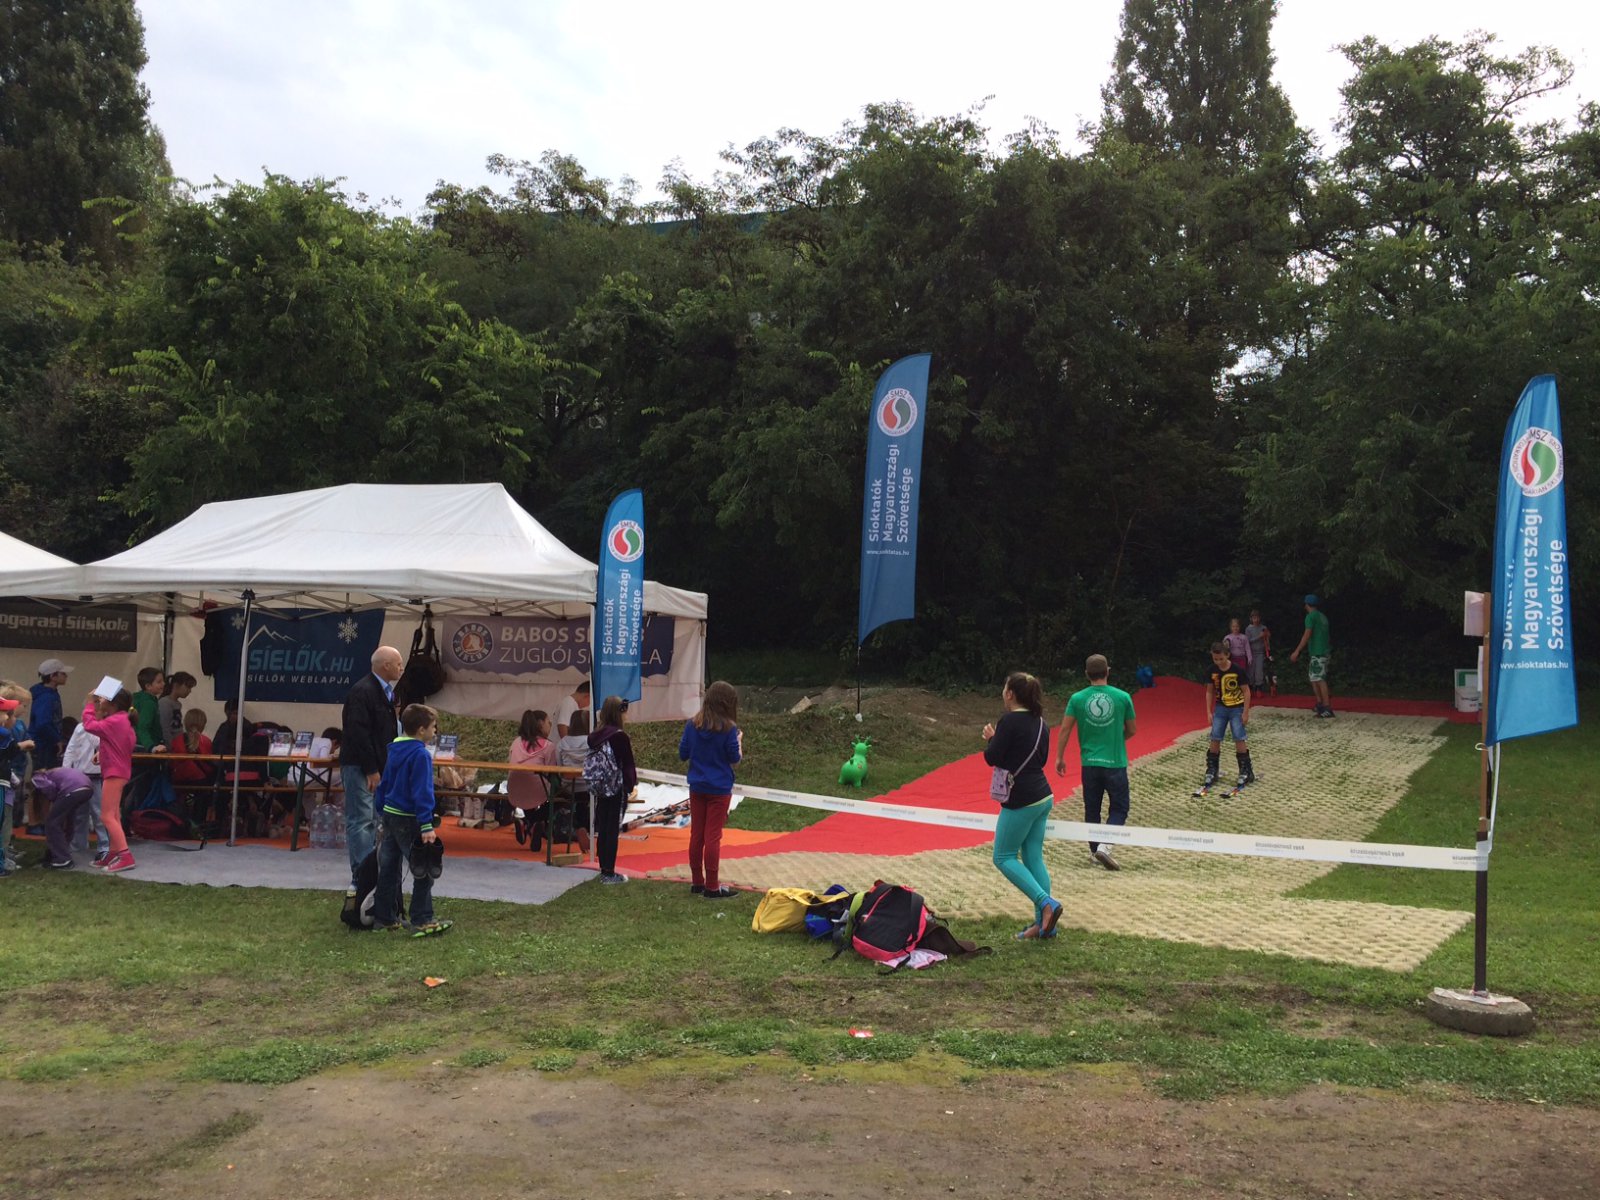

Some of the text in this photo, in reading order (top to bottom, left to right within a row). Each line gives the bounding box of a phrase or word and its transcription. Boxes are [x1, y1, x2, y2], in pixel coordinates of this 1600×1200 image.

[1528, 429, 1549, 441] MSZ
[869, 479, 882, 542] Síoktatók
[883, 444, 900, 542] Magyarországi
[897, 467, 914, 543] Szövetsége
[1520, 508, 1542, 649] Magyarországi
[1545, 539, 1566, 650] Szövetsége
[0, 614, 62, 629] ogarasi
[501, 627, 569, 643] BABOS
[603, 598, 615, 655] Síoktatók
[615, 568, 632, 655] Magyarországi
[629, 589, 644, 656] Szövetsége
[248, 643, 354, 671] SÍELŐK.HU
[291, 674, 350, 684] WEBLAPJA
[500, 645, 571, 664] ZUGLÓI
